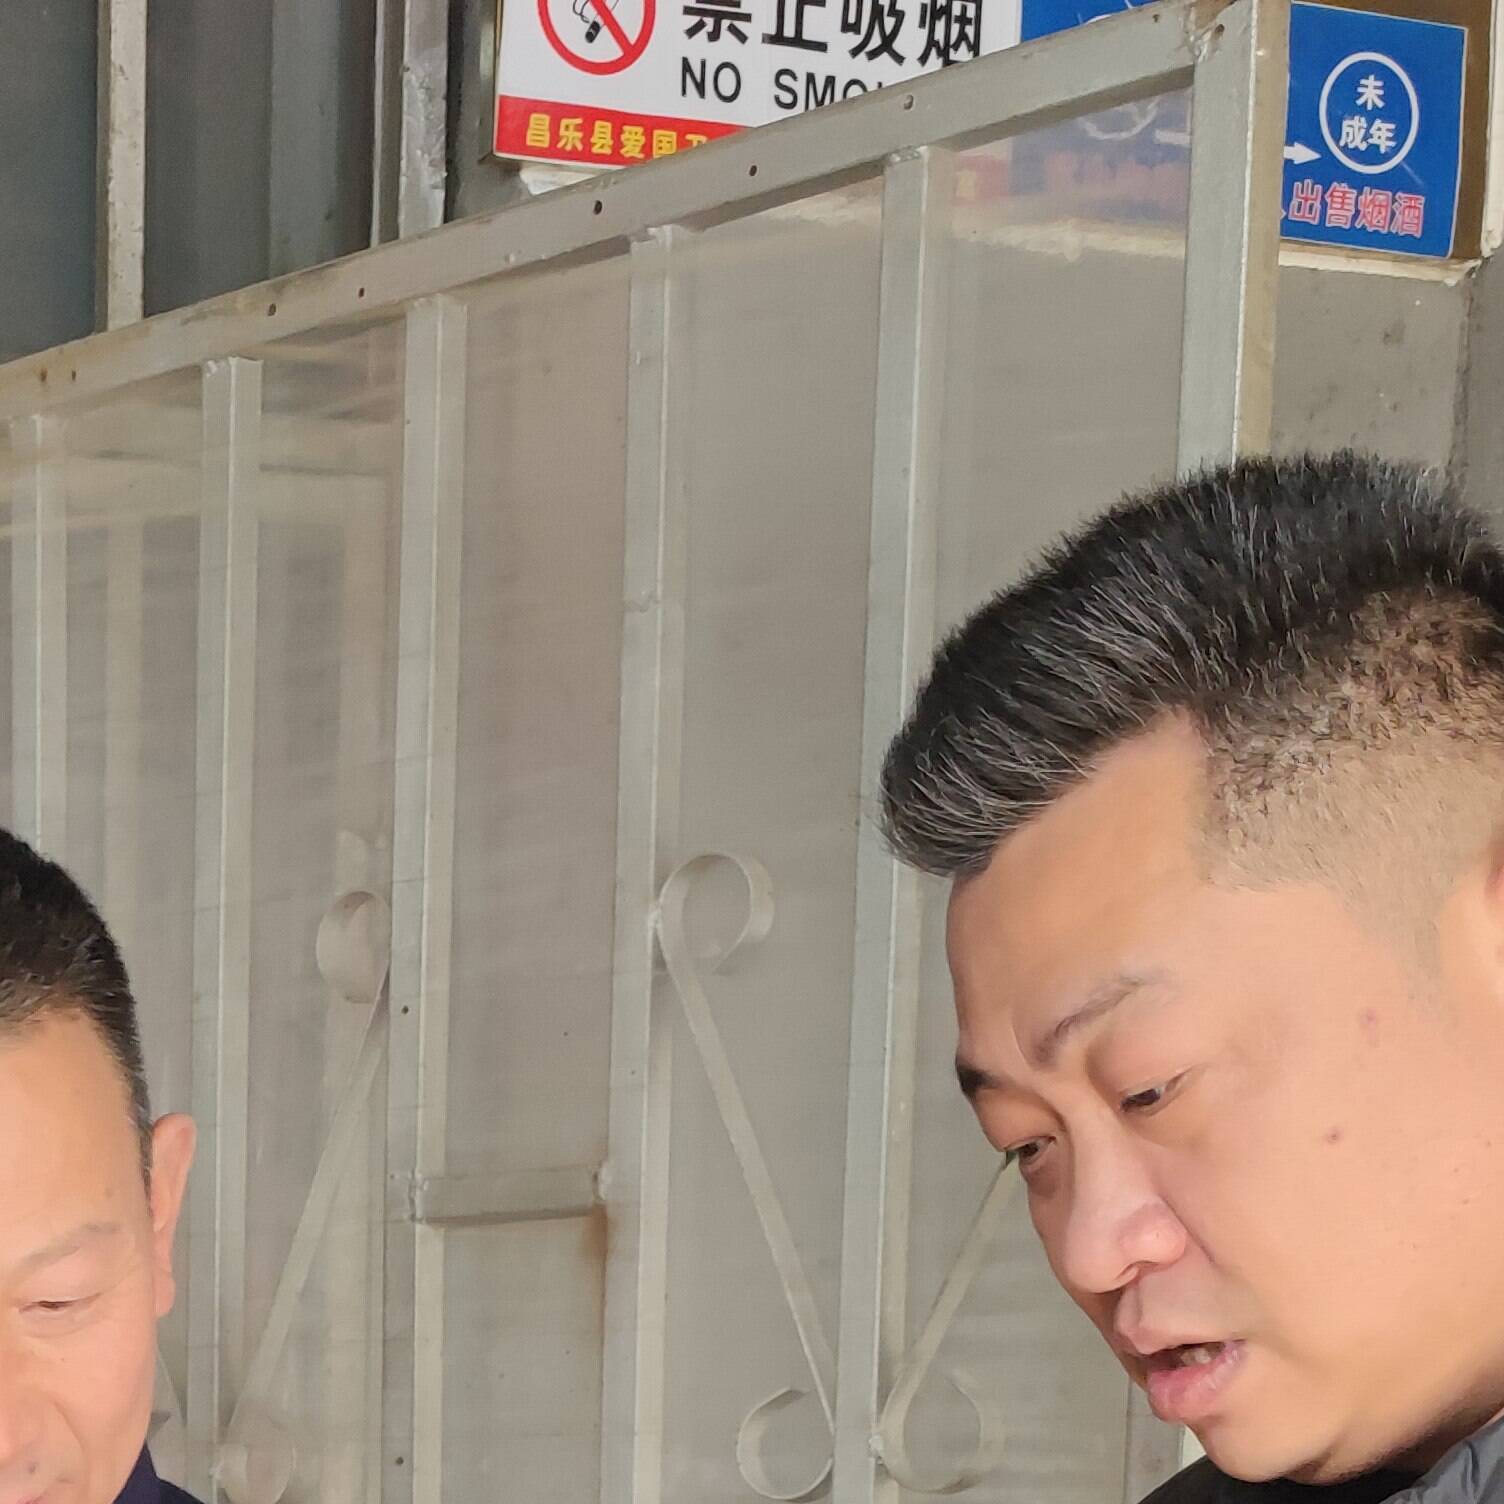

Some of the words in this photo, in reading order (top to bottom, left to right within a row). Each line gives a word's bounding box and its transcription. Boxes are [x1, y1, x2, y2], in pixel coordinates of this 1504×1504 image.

[681, 57, 742, 103] NO
[1356, 74, 1385, 110] 未
[1339, 115, 1397, 154] 成年
